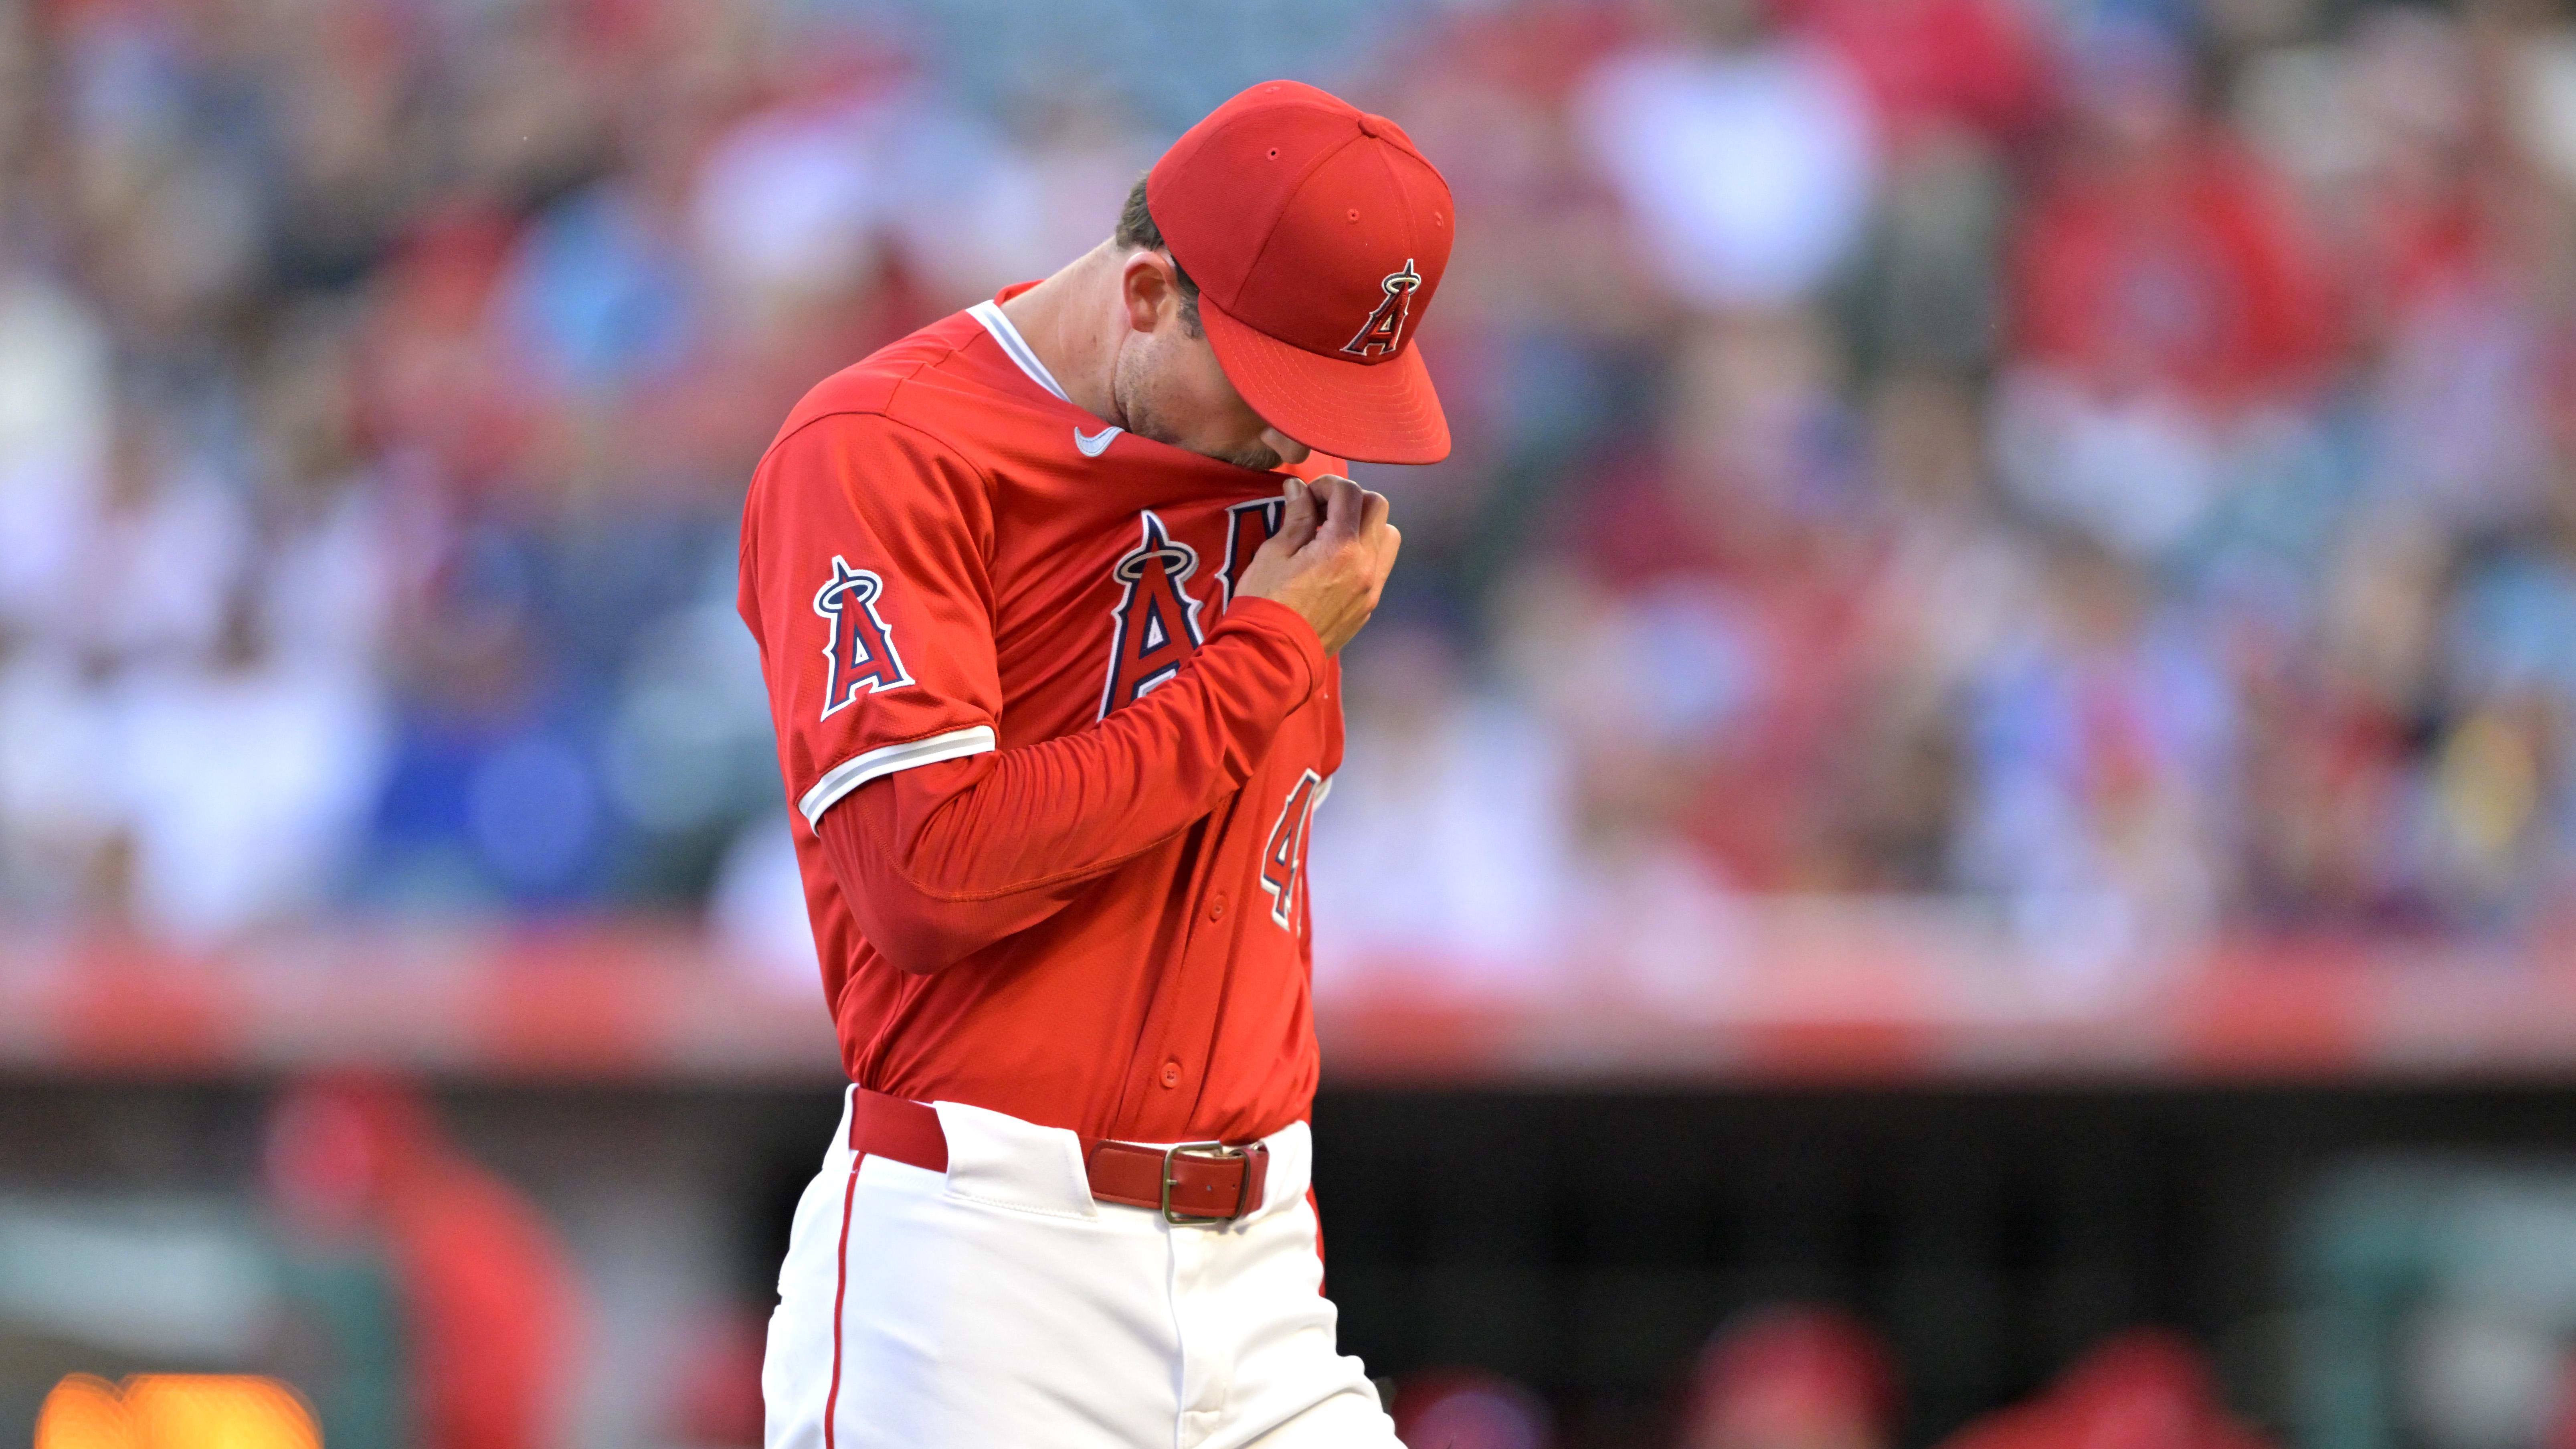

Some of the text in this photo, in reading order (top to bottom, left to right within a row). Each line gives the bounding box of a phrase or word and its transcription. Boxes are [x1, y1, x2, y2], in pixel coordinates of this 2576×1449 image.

[1339, 258, 1421, 356] A
[813, 555, 916, 722] A
[1261, 767, 1332, 939] 4
